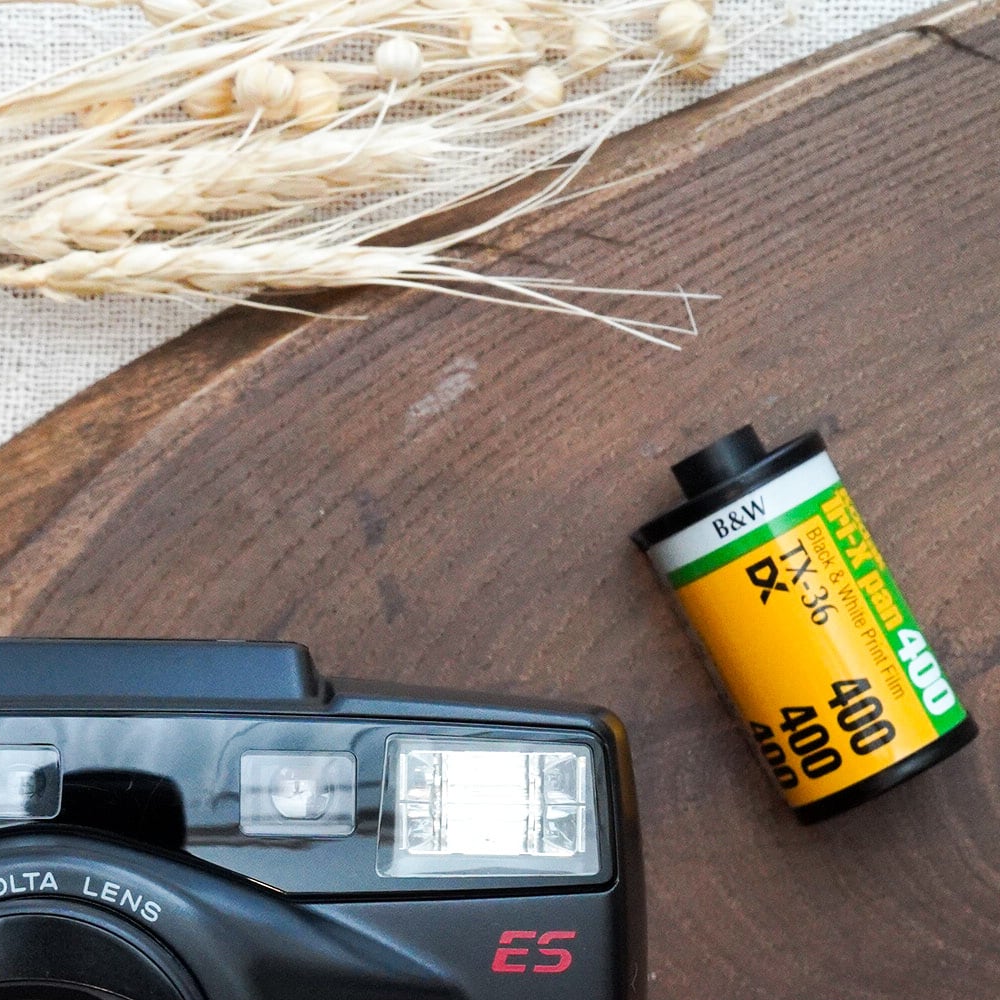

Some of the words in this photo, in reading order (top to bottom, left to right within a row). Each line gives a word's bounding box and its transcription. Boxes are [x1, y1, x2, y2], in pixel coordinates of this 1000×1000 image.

[712, 495, 766, 539] B&W
[745, 555, 790, 605] DX
[779, 538, 839, 625] TX-36
[806, 526, 835, 569] Black
[829, 569, 845, 584] &
[838, 583, 867, 629] White
[861, 627, 887, 666] Print
[880, 663, 905, 700] Film
[820, 490, 874, 569] Tri-X
[856, 569, 904, 631] pan
[896, 627, 956, 716] 400
[780, 706, 842, 779] 400
[827, 678, 896, 755] 400
[82, 876, 162, 922] LENS
[491, 930, 577, 973] ES
